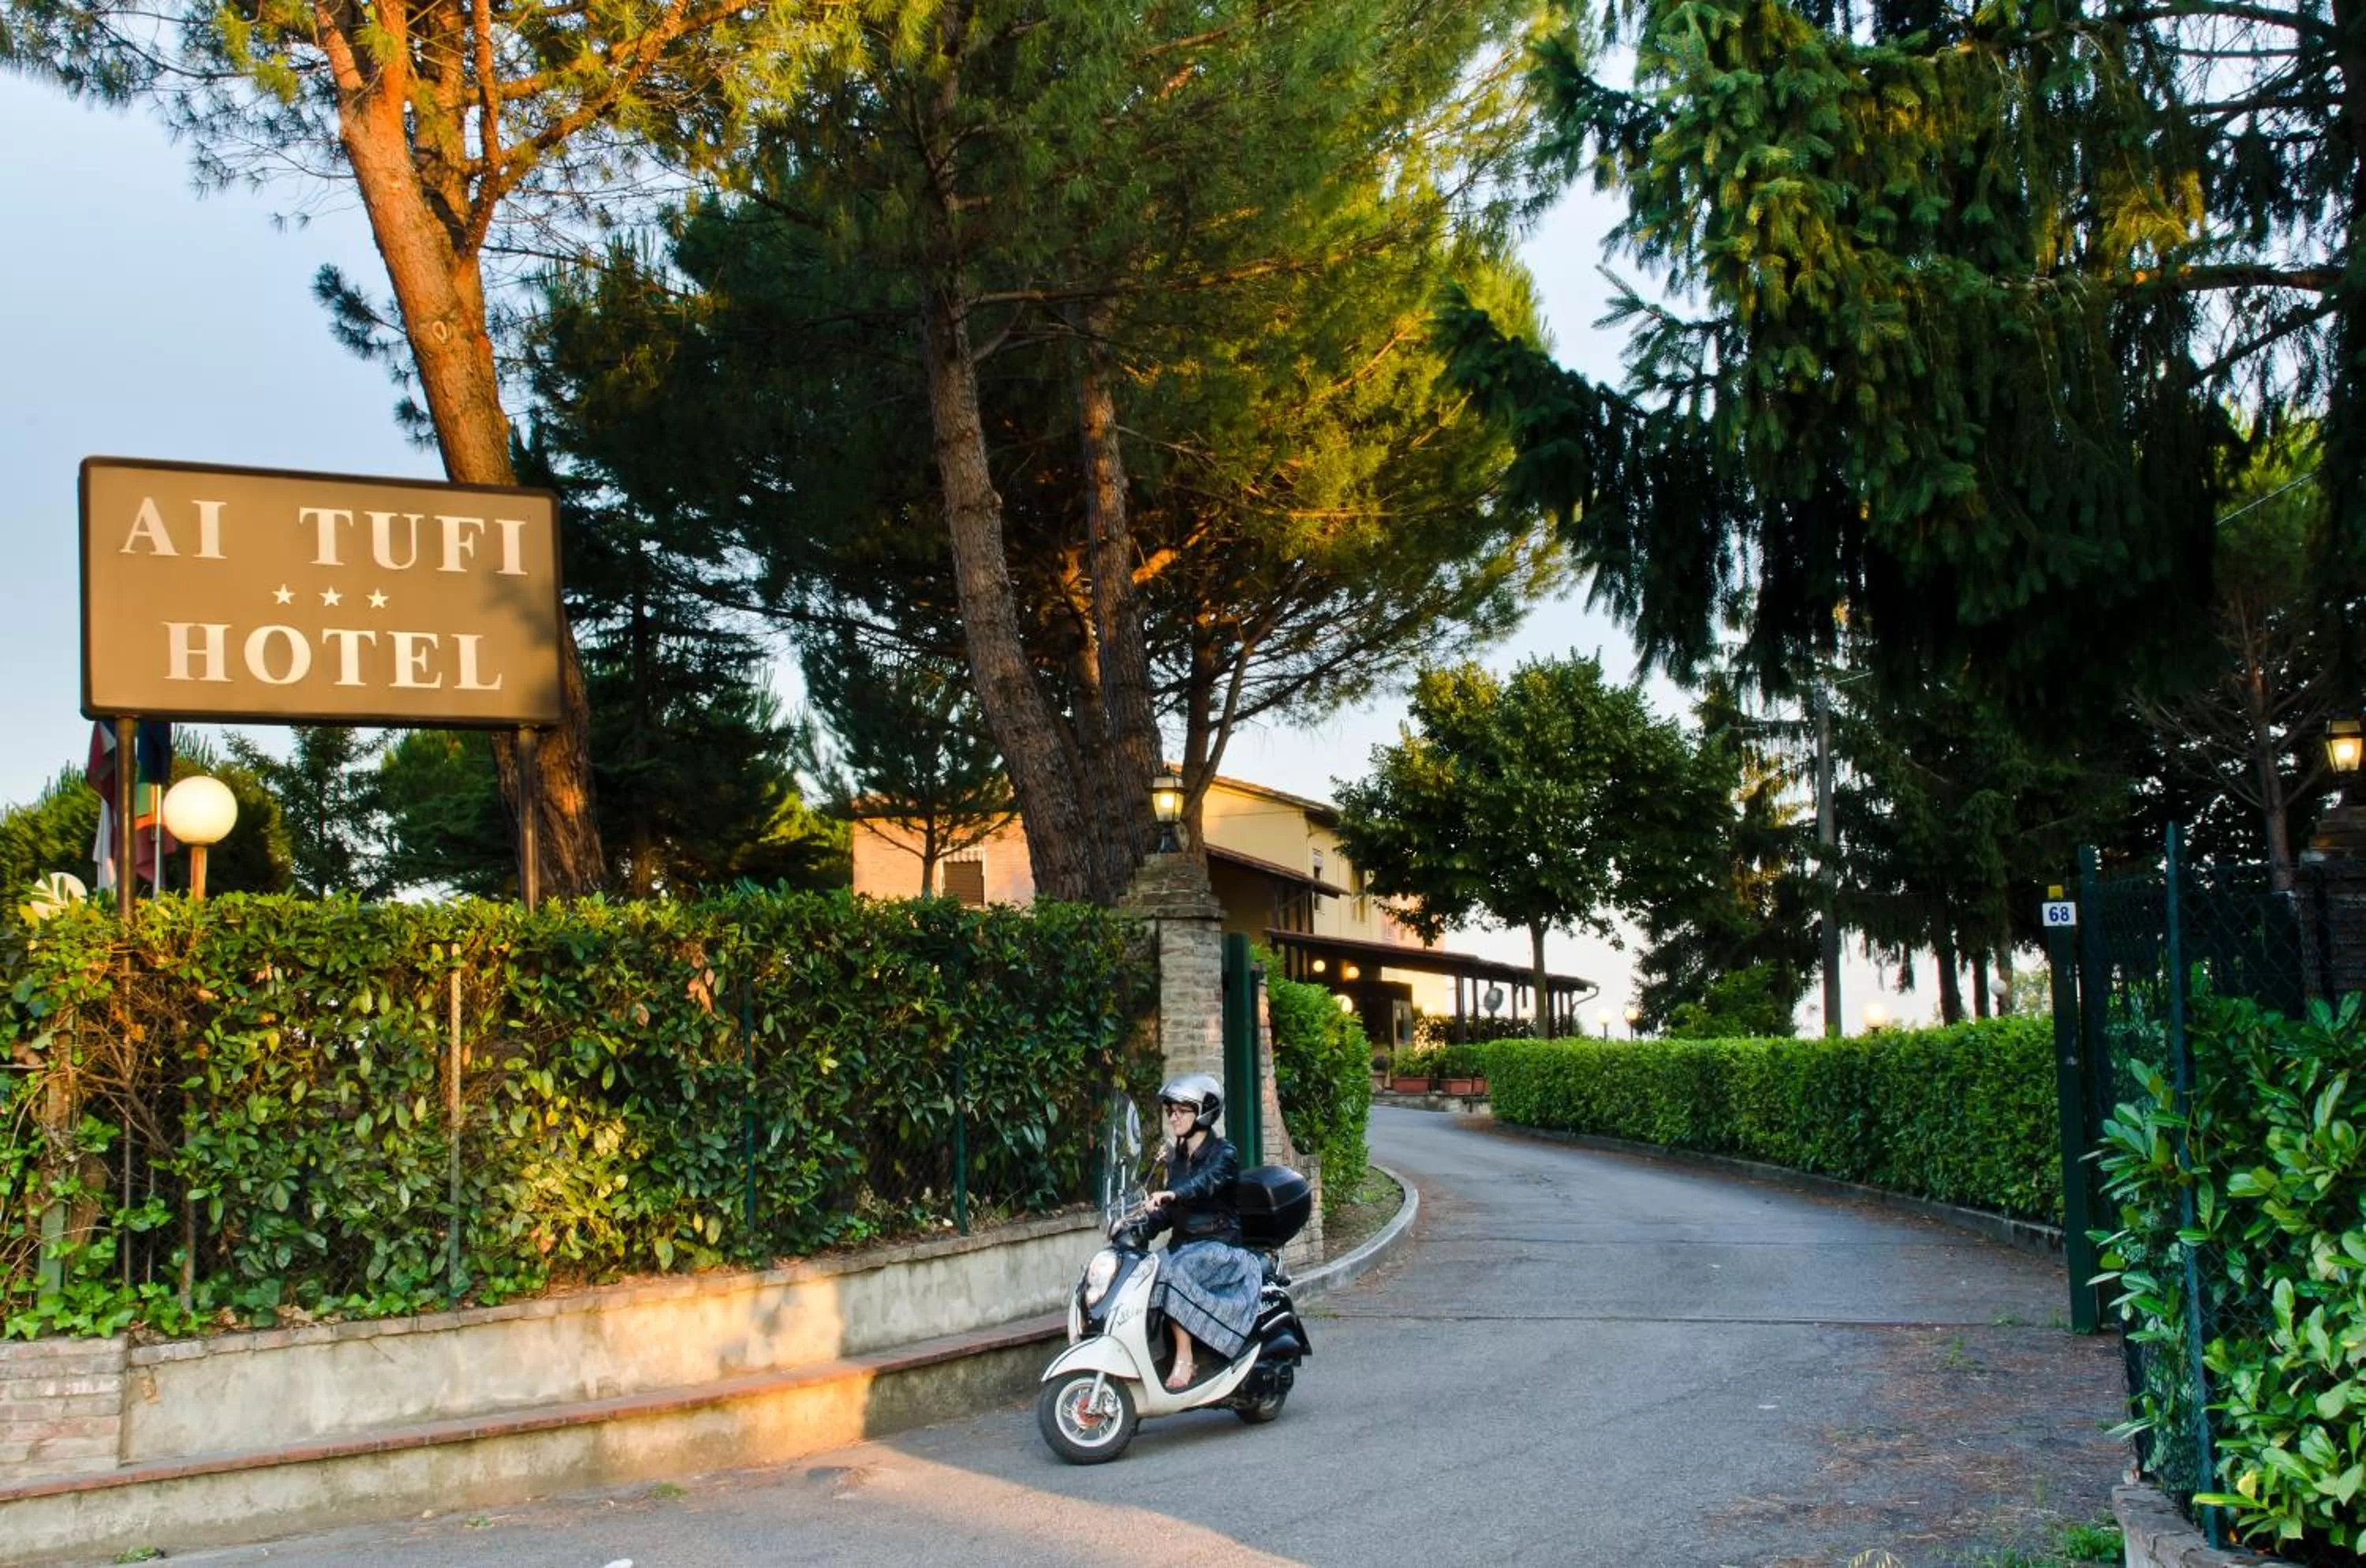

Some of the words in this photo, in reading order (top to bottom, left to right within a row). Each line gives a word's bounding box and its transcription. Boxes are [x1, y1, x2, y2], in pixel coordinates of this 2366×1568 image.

[119, 496, 228, 559] AI
[299, 505, 528, 575] TUFI
[162, 621, 502, 691] HOTEL
[2048, 906, 2070, 922] 68
